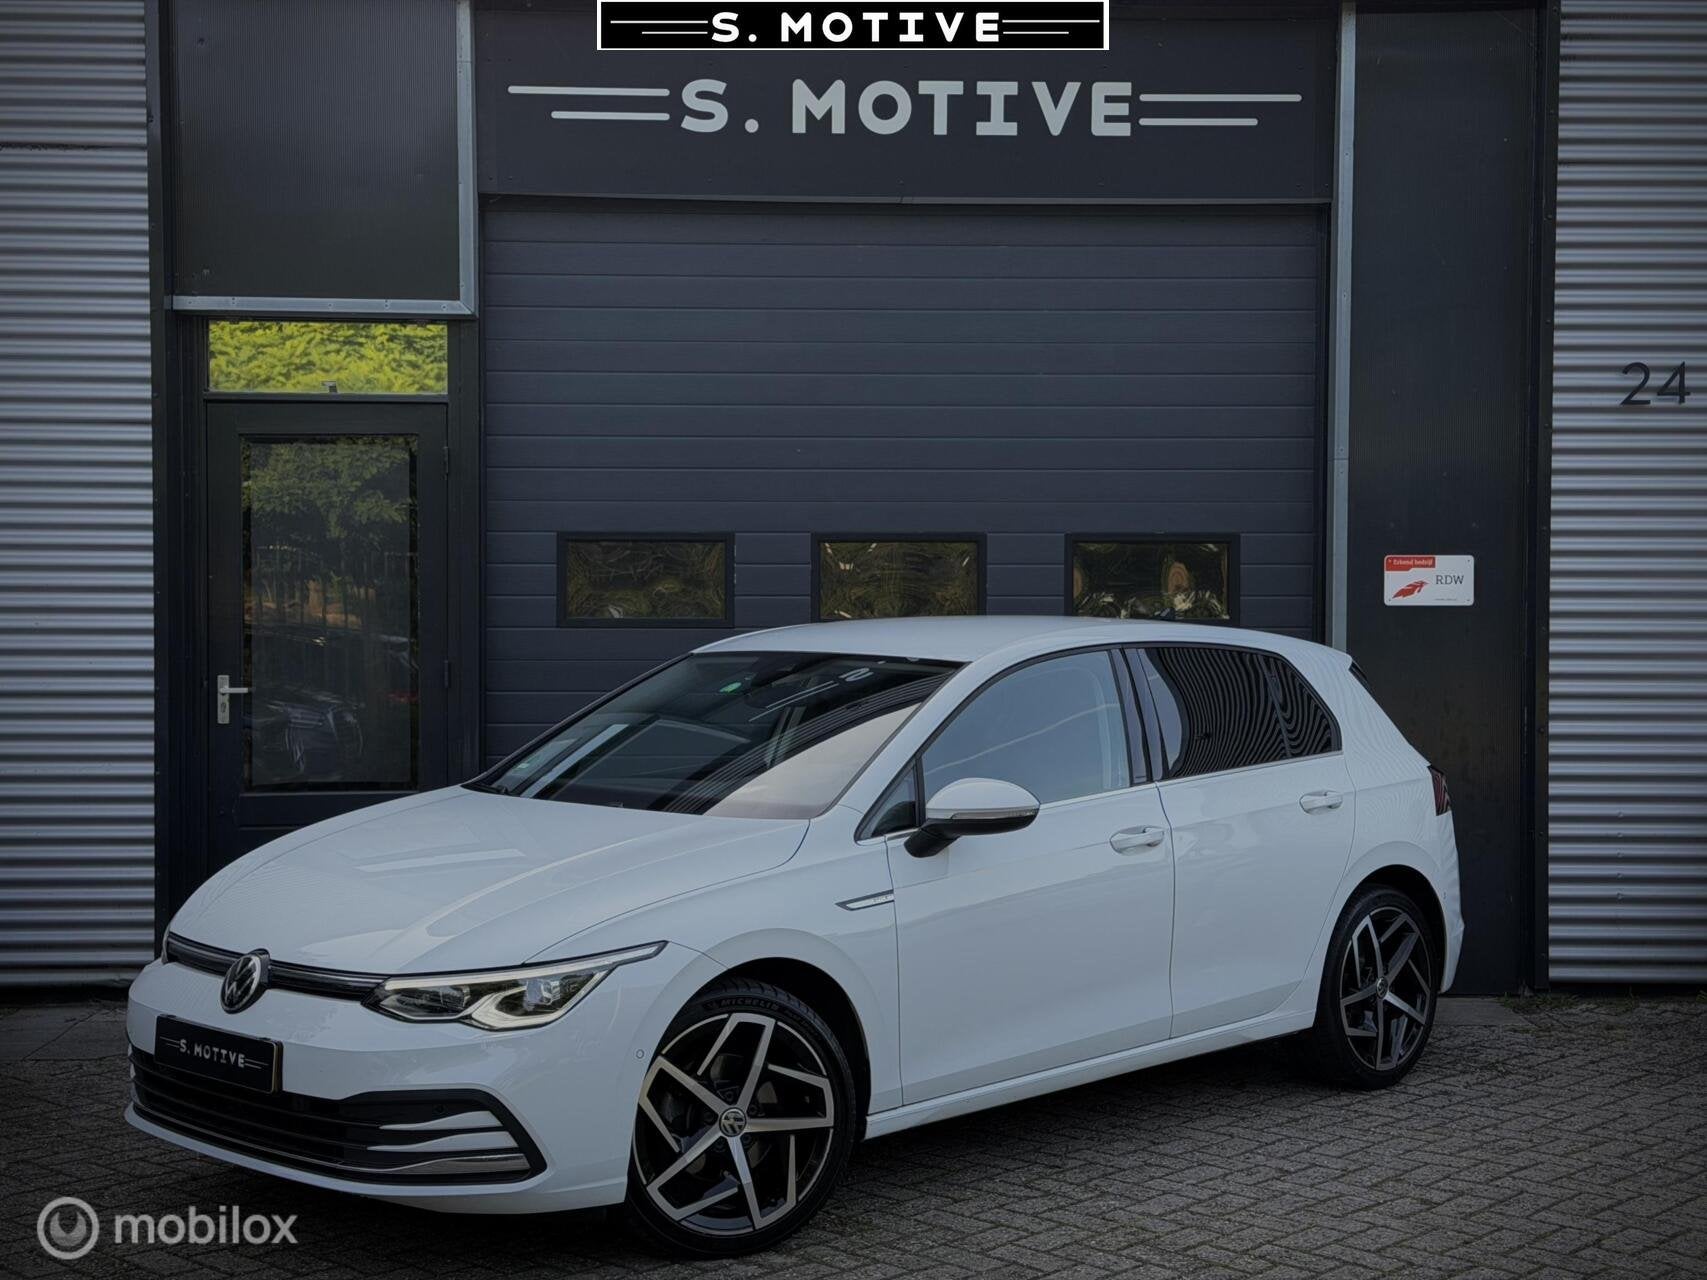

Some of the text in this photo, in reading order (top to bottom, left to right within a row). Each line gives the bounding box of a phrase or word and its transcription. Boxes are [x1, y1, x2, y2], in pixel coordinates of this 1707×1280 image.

[681, 78, 1132, 137] S. MOTIVE
[1621, 361, 1690, 405] 24
[1435, 575, 1464, 585] RDW
[179, 1038, 246, 1068] S. MOTIVE
